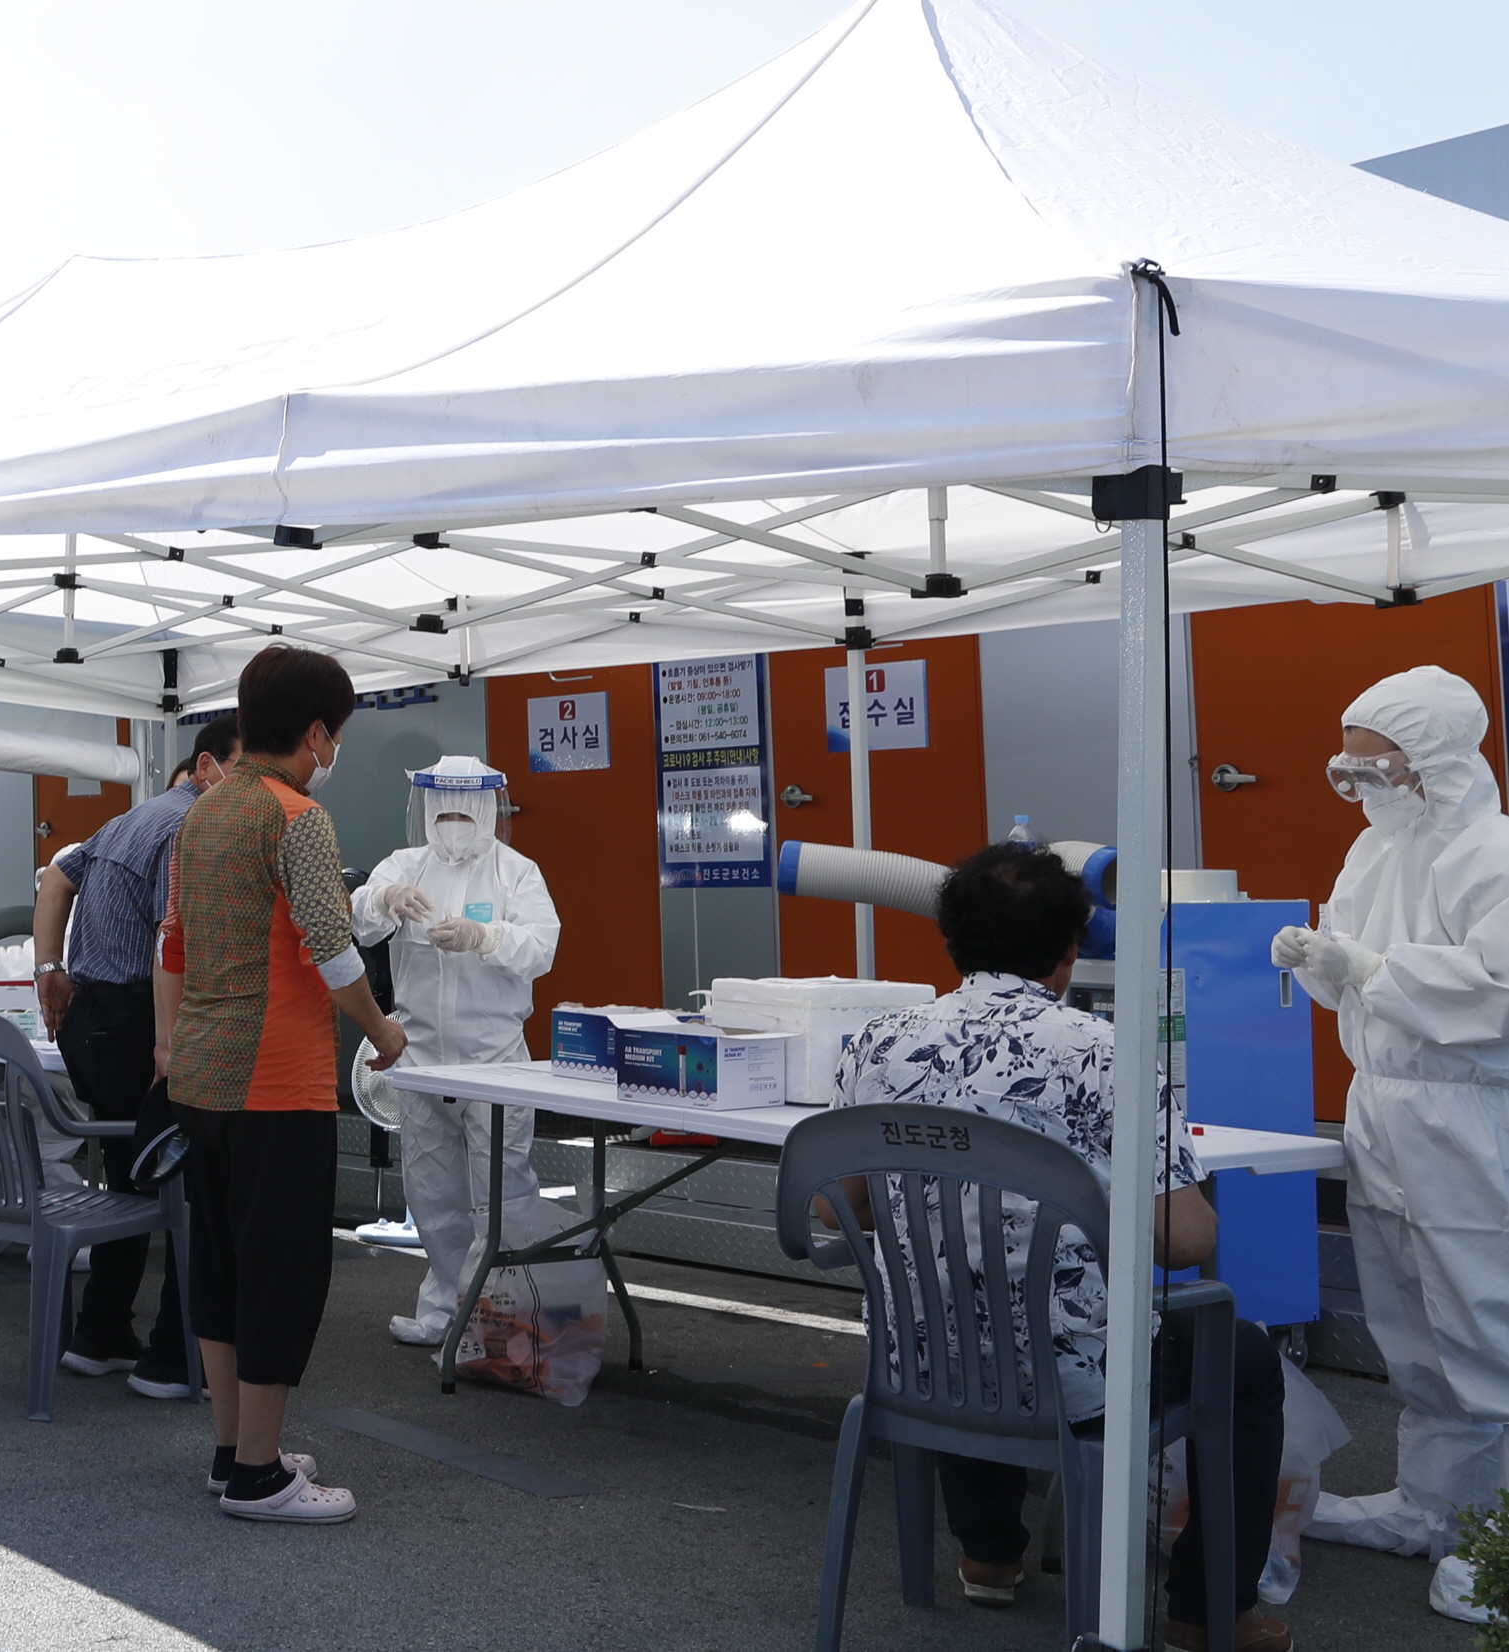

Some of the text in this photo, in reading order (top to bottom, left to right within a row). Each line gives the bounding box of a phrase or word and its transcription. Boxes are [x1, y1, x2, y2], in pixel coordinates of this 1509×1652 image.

[708, 662, 726, 674] 있으면
[728, 660, 753, 672] 검사받기
[703, 676, 722, 688] 인후통
[869, 671, 877, 691] 1
[697, 689, 741, 701] 09:00~18:00
[563, 702, 573, 719] 2
[705, 715, 748, 728] 12:00~13:00
[539, 724, 600, 752] 검사실
[699, 730, 747, 742] 061-540-6074
[692, 750, 705, 767] 검사
[706, 750, 712, 766] 후
[683, 777, 689, 788] 후
[691, 777, 701, 787] 도보
[702, 776, 713, 786] 또는
[737, 774, 749, 785] 귀가
[692, 789, 702, 800] 착용
[703, 789, 709, 800] 및
[710, 788, 732, 799] 타인과의
[745, 786, 759, 798] 자제)
[695, 803, 706, 813] 확인
[703, 868, 760, 881] 진도군보건소
[624, 1046, 662, 1057] AB TRANSPORT
[624, 1053, 646, 1062] MEDIUM
[881, 1122, 971, 1152] 진도군청
